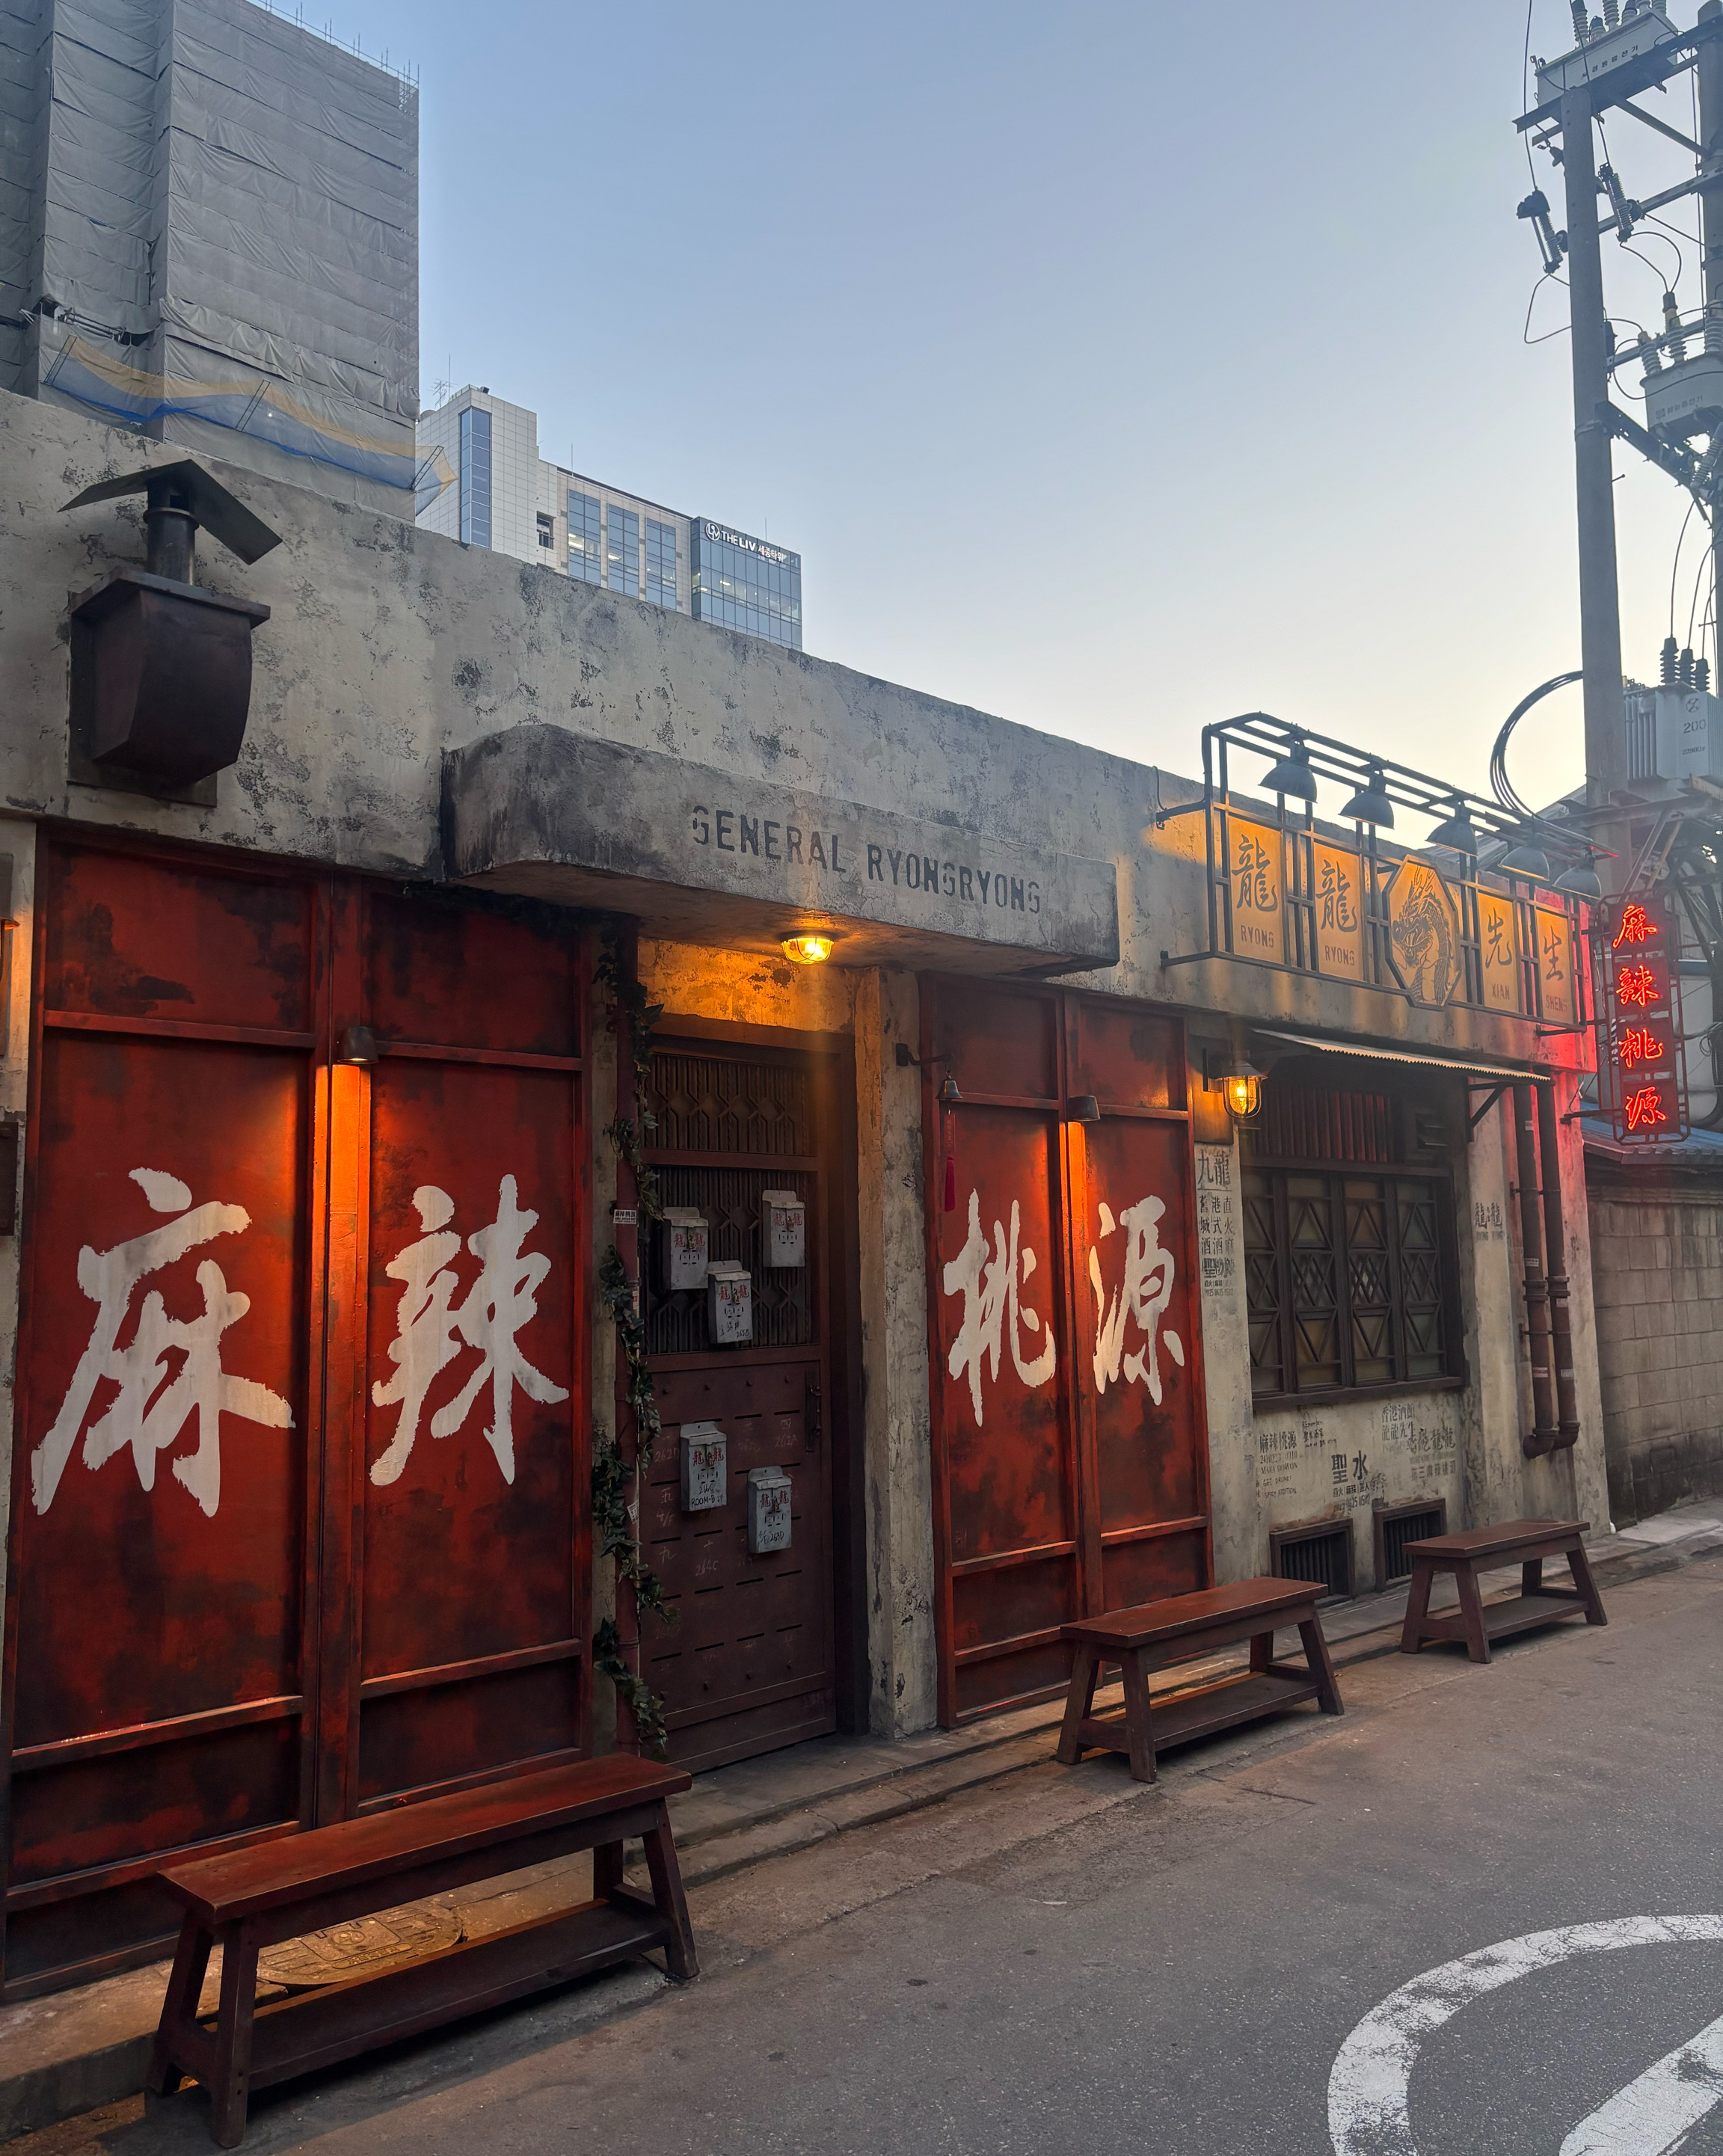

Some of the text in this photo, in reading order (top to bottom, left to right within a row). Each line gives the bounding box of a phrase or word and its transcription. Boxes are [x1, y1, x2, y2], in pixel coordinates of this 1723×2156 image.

[721, 530, 784, 562] THE LIV 세종타워
[1683, 719, 1706, 734] 200
[692, 805, 1040, 915] GENERAL RYONGRYONG
[1241, 924, 1274, 949] RYONG
[1324, 945, 1355, 967] RYONG
[1491, 983, 1510, 1001] XIAN
[1545, 994, 1568, 1013] SHENG
[1331, 1450, 1369, 1484] 聖水
